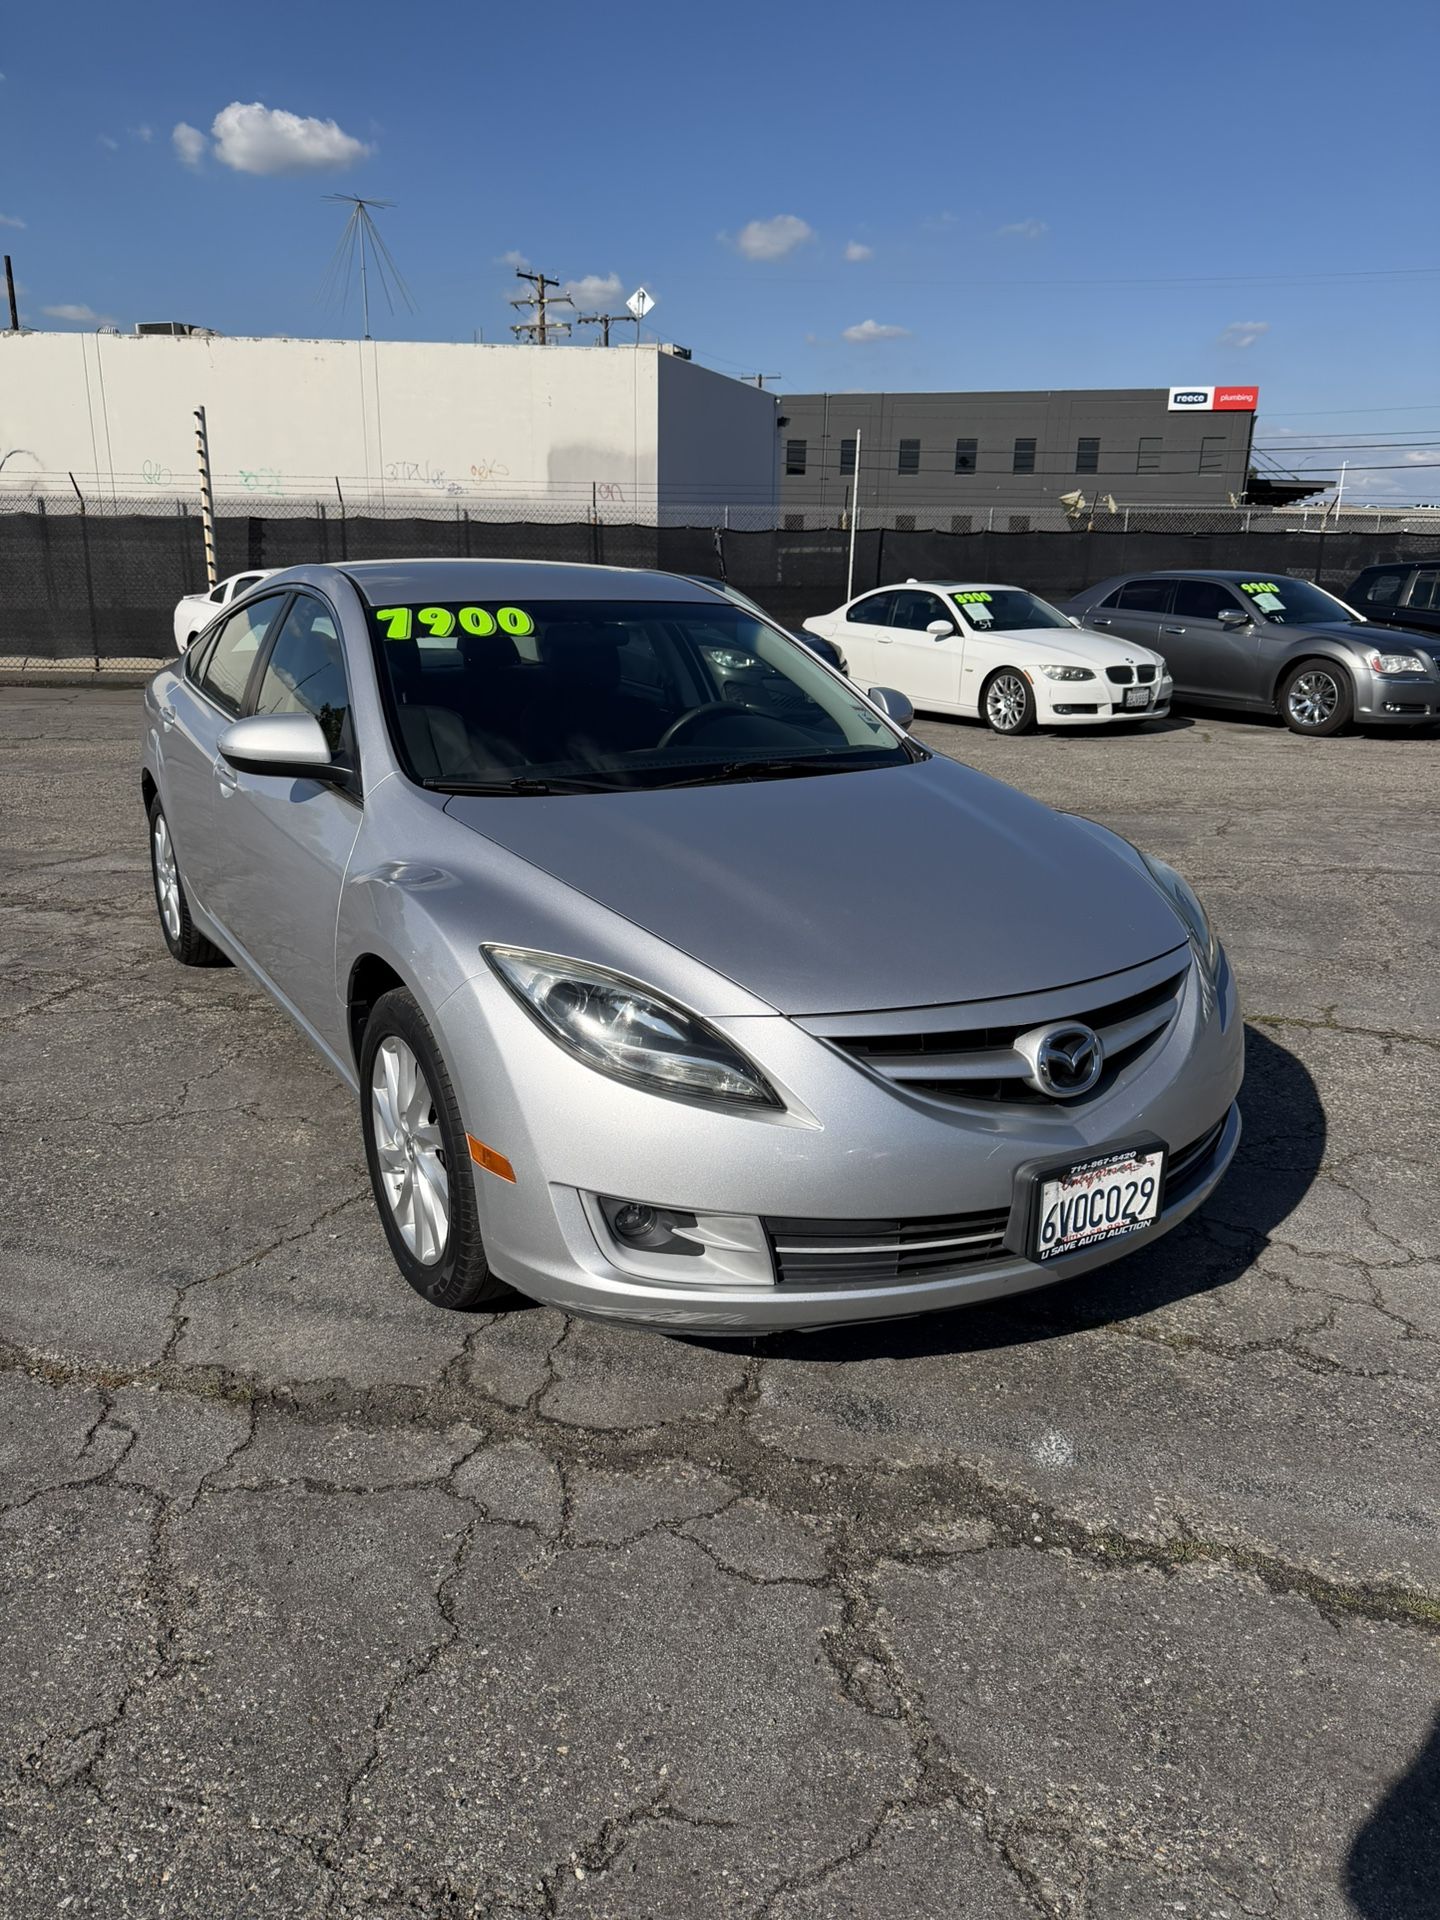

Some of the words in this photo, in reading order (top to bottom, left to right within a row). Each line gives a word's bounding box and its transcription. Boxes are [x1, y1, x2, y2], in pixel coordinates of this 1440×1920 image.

[1220, 393, 1253, 402] plumbing
[1240, 582, 1281, 593] 9900
[954, 592, 993, 604] 8900
[377, 606, 534, 640] 7900
[1071, 1150, 1137, 1174] 714-867-6420
[1041, 1250, 1049, 1260] U
[1051, 1242, 1077, 1256] SAVE
[1078, 1231, 1106, 1245] AUTO
[1107, 1220, 1152, 1237] AUCTION
